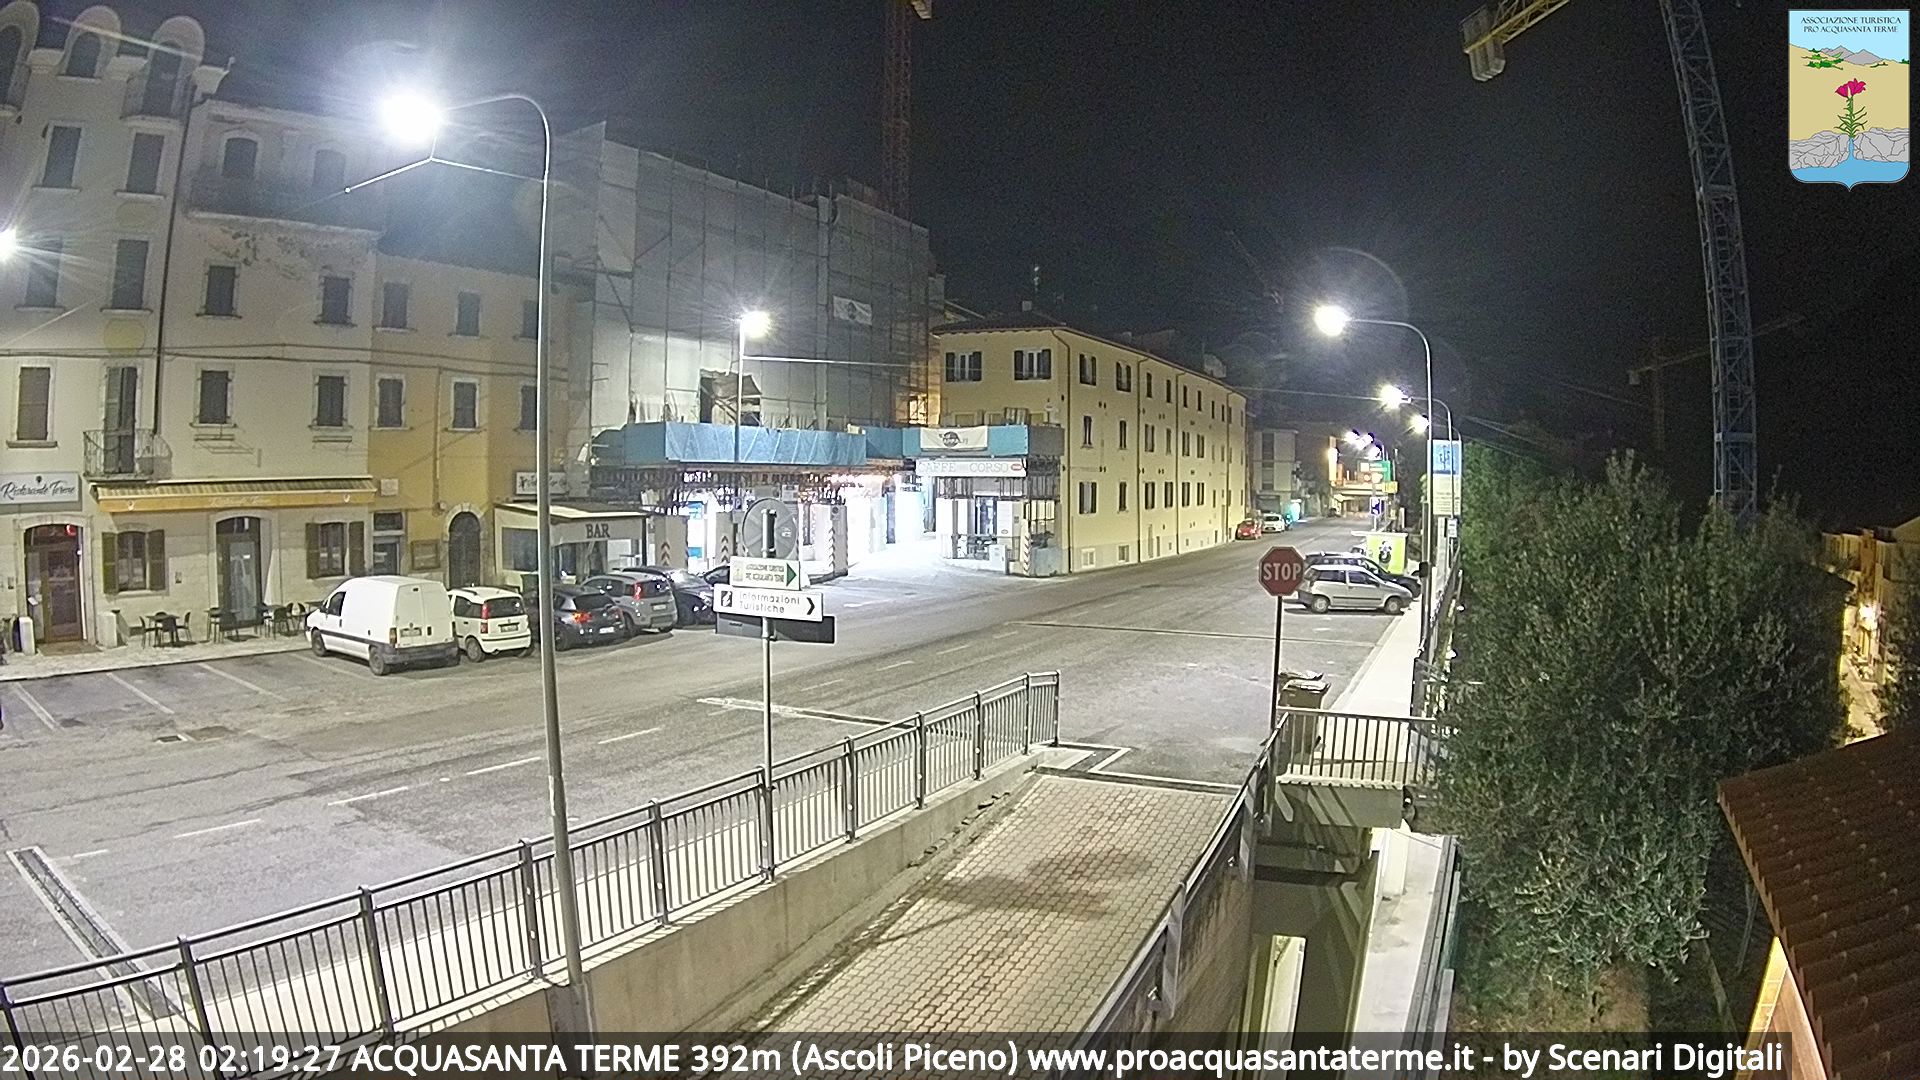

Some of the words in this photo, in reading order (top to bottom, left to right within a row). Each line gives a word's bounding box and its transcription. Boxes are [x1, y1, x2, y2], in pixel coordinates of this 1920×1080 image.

[968, 462, 1009, 473] CORSO
[585, 523, 610, 539] BAR
[1263, 562, 1302, 580] STOP
[739, 593, 800, 605] Informazioni
[739, 601, 785, 613] Turistiche
